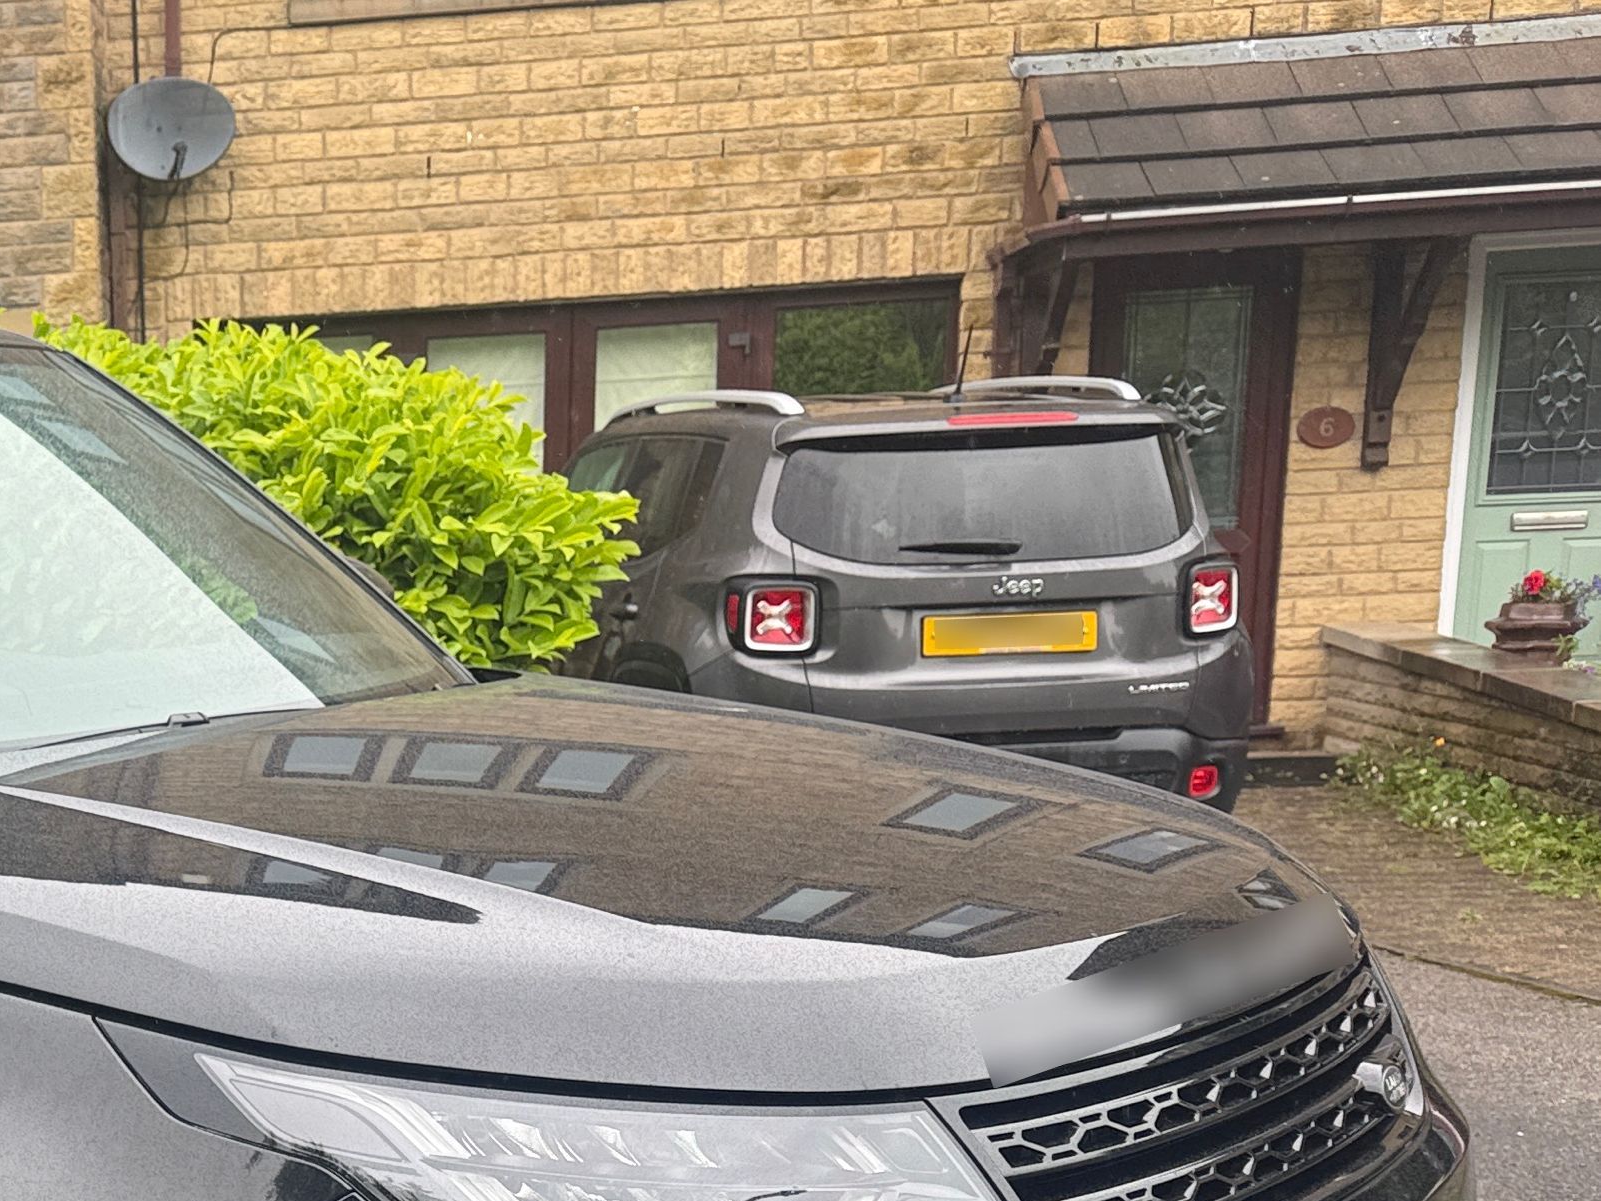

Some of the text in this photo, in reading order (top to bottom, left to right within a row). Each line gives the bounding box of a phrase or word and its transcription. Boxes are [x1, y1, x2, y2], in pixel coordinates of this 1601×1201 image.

[1319, 417, 1336, 437] 6
[992, 576, 1044, 598] Jeep
[1128, 681, 1190, 694] LIMITED
